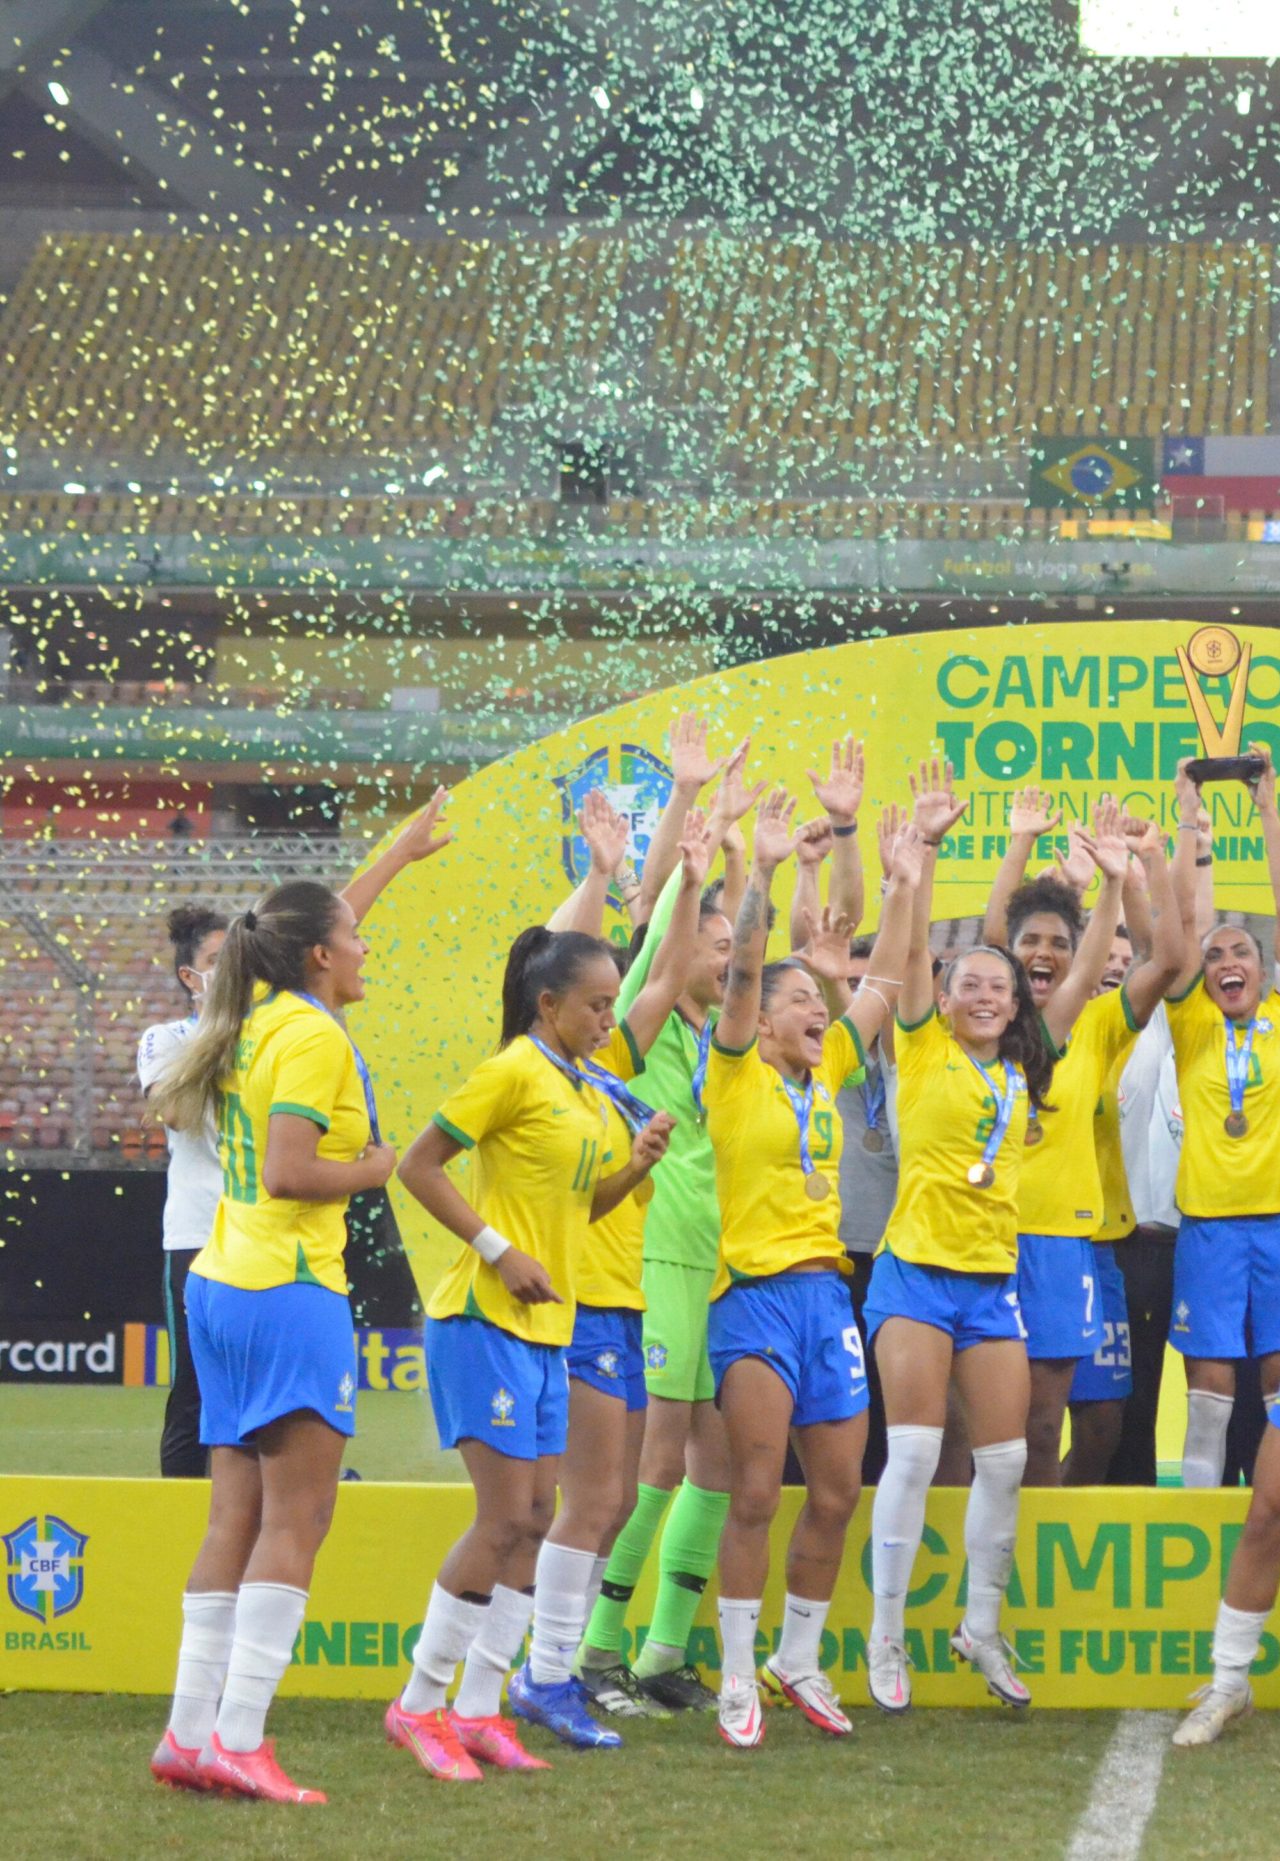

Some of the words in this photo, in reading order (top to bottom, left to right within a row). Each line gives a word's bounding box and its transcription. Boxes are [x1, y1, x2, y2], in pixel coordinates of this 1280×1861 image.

[1014, 563, 1035, 575] se
[1036, 561, 1078, 579] joga
[572, 1137, 597, 1192] 11
[1082, 1275, 1094, 1323] 7
[841, 1326, 866, 1378] 9
[1094, 1321, 1132, 1366] 23
[29, 1558, 60, 1573] CBF
[5, 1631, 91, 1651] BRASIL
[968, 1629, 1045, 1674] E
